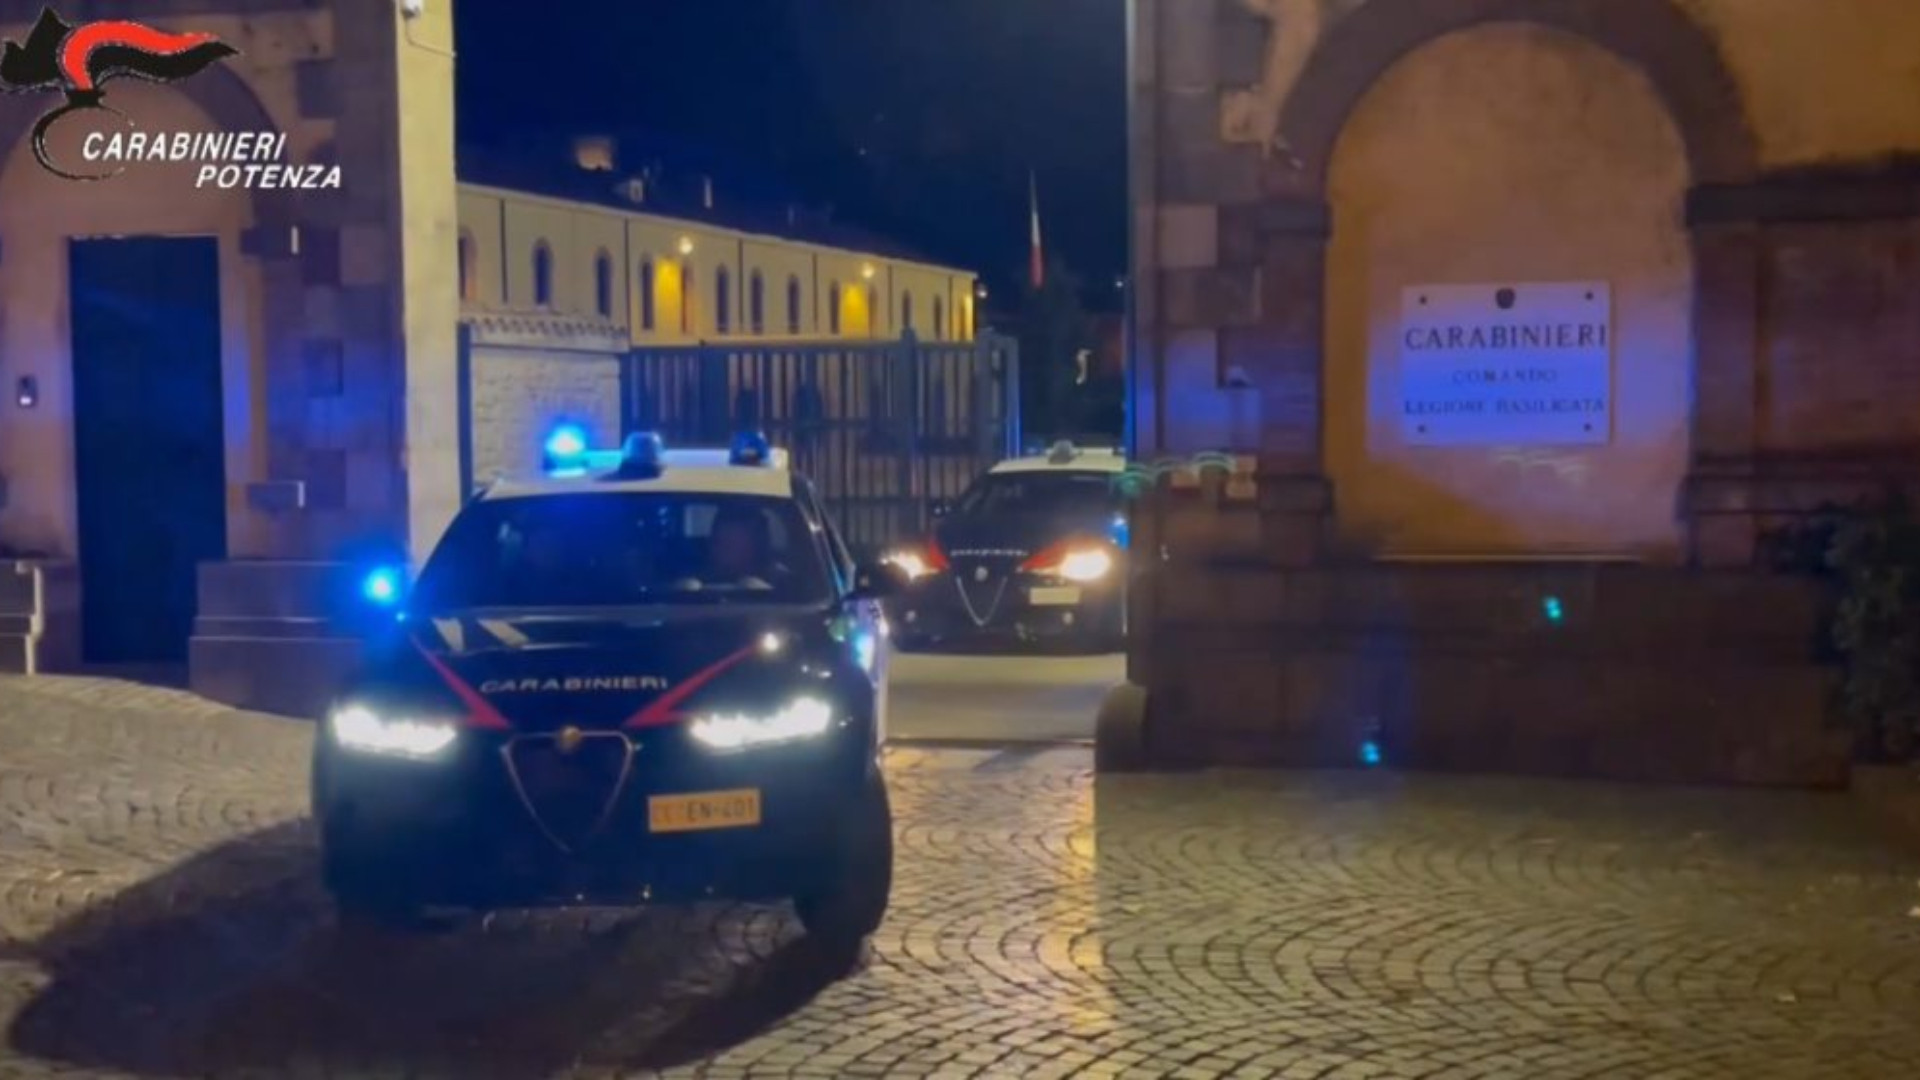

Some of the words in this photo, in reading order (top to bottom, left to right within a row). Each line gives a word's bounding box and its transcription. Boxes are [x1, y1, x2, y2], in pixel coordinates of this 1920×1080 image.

[1404, 324, 1607, 350] CARABINIERI
[1452, 368, 1558, 386] COMANDO
[480, 676, 669, 693] CARABINIERI
